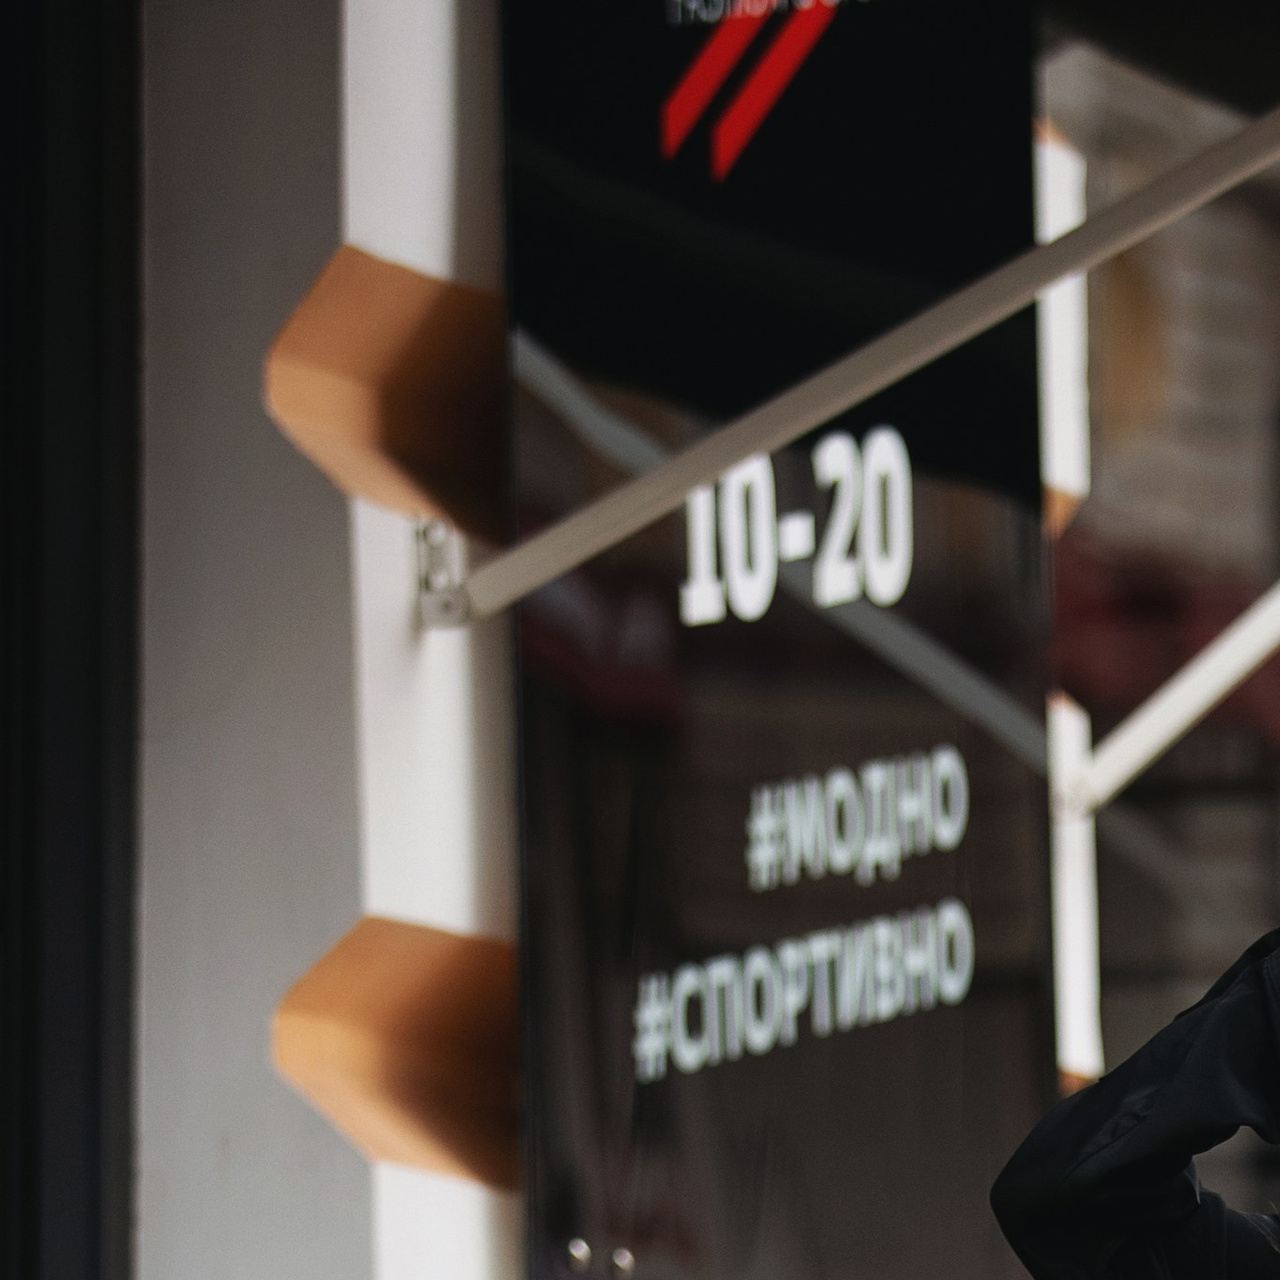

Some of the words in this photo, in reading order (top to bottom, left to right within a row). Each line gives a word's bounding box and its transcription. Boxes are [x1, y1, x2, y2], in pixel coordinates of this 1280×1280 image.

[679, 425, 914, 627] 10-20
[745, 743, 970, 892] #МОДНО
[633, 896, 976, 1084] #СПОРТИВНО
